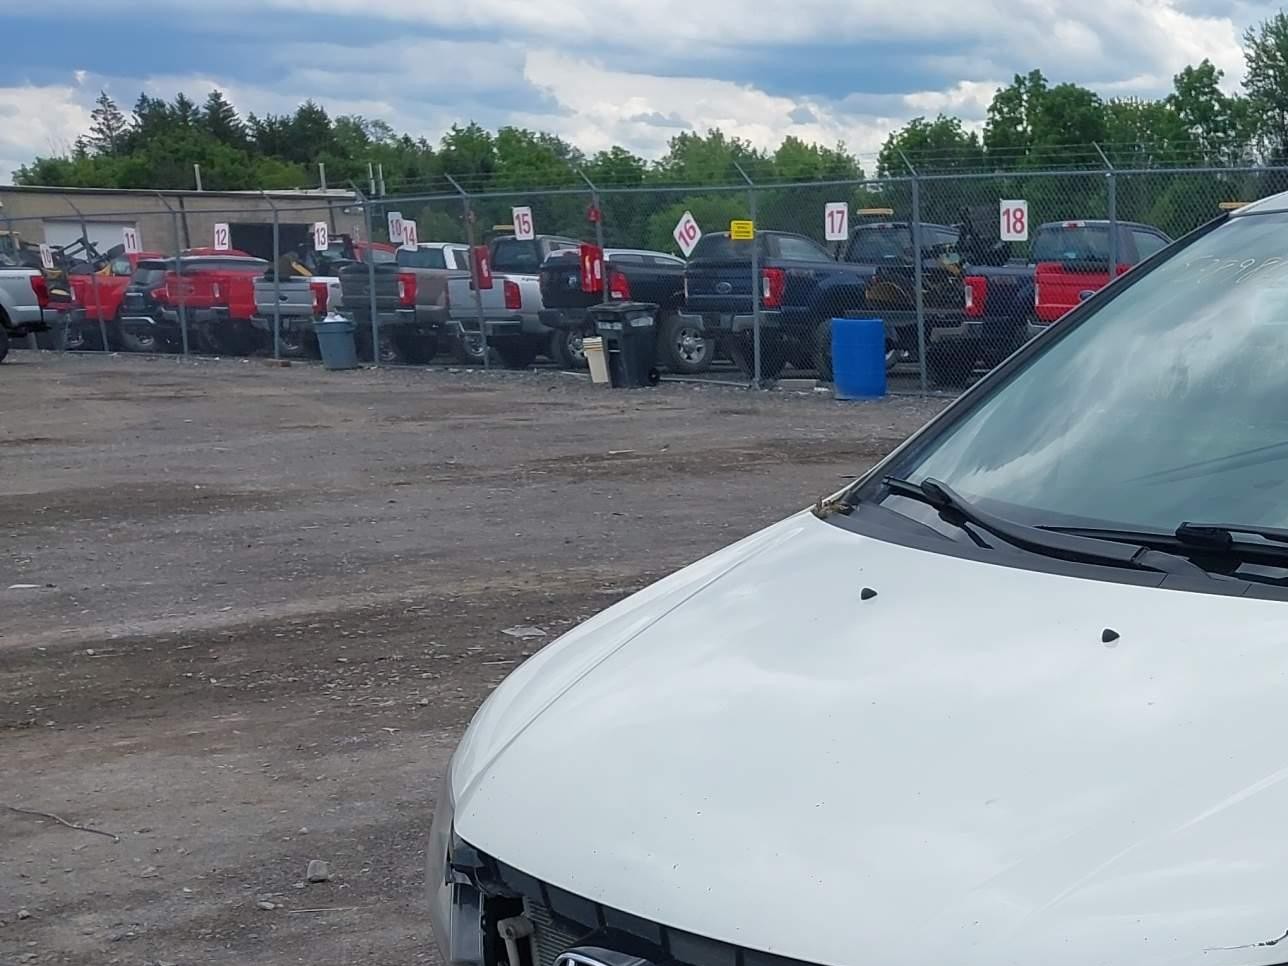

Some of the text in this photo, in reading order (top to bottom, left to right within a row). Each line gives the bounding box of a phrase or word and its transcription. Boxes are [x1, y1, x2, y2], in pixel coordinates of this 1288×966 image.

[515, 213, 532, 234] 15
[827, 209, 845, 234] 17
[1002, 207, 1025, 234] 18
[125, 232, 137, 250] 11
[215, 228, 227, 247] 12
[316, 227, 326, 247] 13
[403, 226, 415, 246] 14
[678, 219, 697, 247] 16
